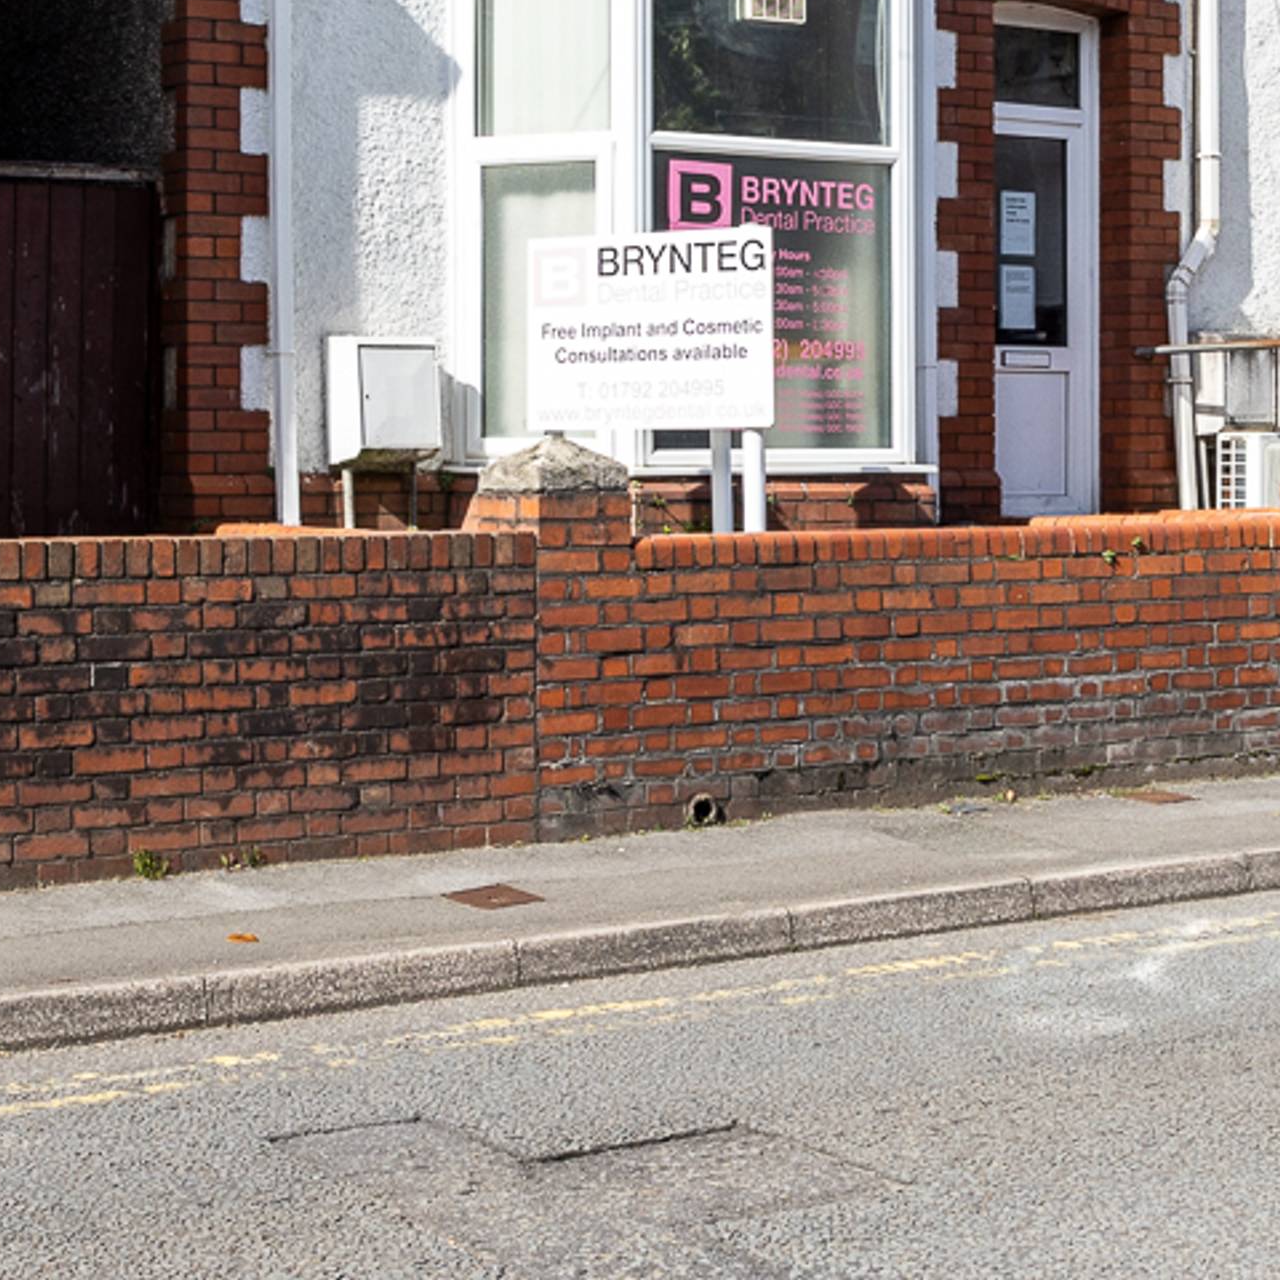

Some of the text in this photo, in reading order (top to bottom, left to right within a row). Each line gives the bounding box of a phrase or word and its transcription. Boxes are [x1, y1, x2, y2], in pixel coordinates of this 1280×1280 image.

[677, 171, 723, 224] B
[740, 176, 876, 211] BRYNTEG
[803, 210, 876, 235] Practice
[597, 238, 767, 278] BRYNTEG
[598, 278, 767, 304] Dental Practice
[541, 318, 764, 342] Free Implant and Cosmetic
[554, 343, 749, 364] Consultations available
[600, 380, 652, 399] 01792
[658, 379, 726, 398] 204995
